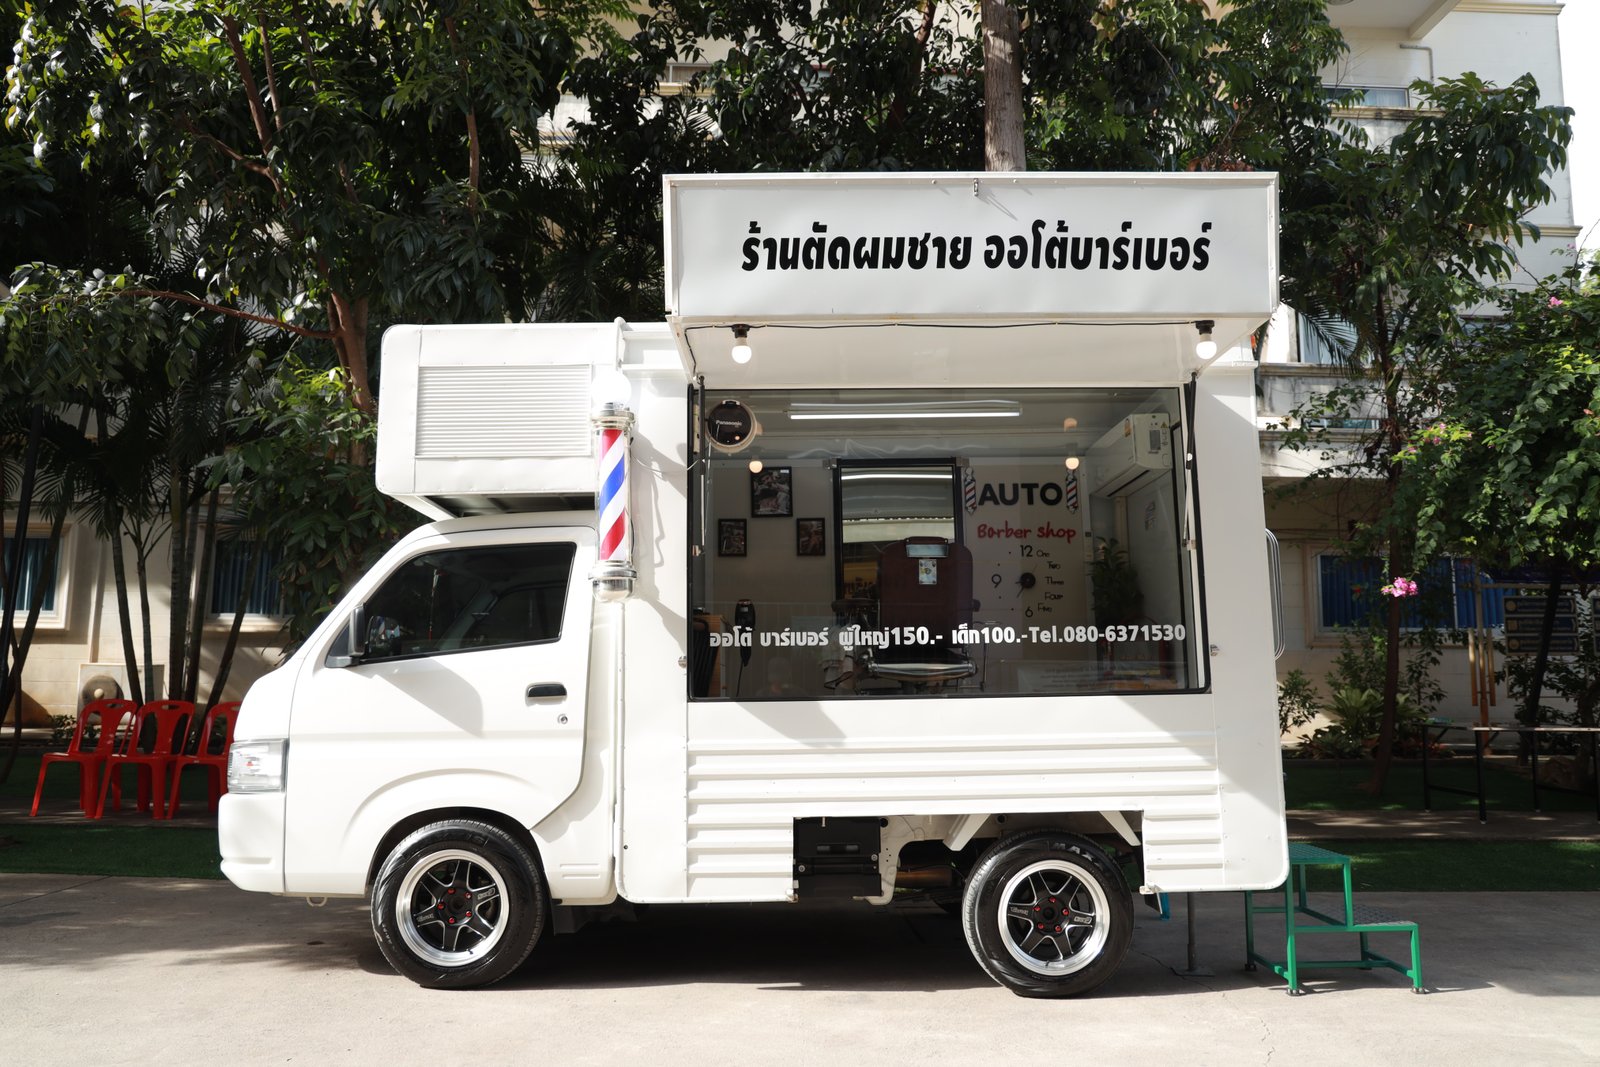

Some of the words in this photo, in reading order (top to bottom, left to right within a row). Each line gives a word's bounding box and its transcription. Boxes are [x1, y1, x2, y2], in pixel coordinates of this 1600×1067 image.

[741, 220, 973, 272] ร้านตัดผมชาย
[983, 219, 1213, 271] ออโต้บาร์เบอร์
[978, 482, 1063, 506] AUTO
[977, 520, 1032, 539] Barber
[1036, 521, 1077, 544] shop
[1020, 544, 1033, 557] 12
[1036, 549, 1050, 558] One
[991, 573, 1002, 588] 9
[1025, 606, 1034, 618] 6
[709, 625, 753, 647] ออโต้
[760, 626, 829, 647] บาร์เบอร์
